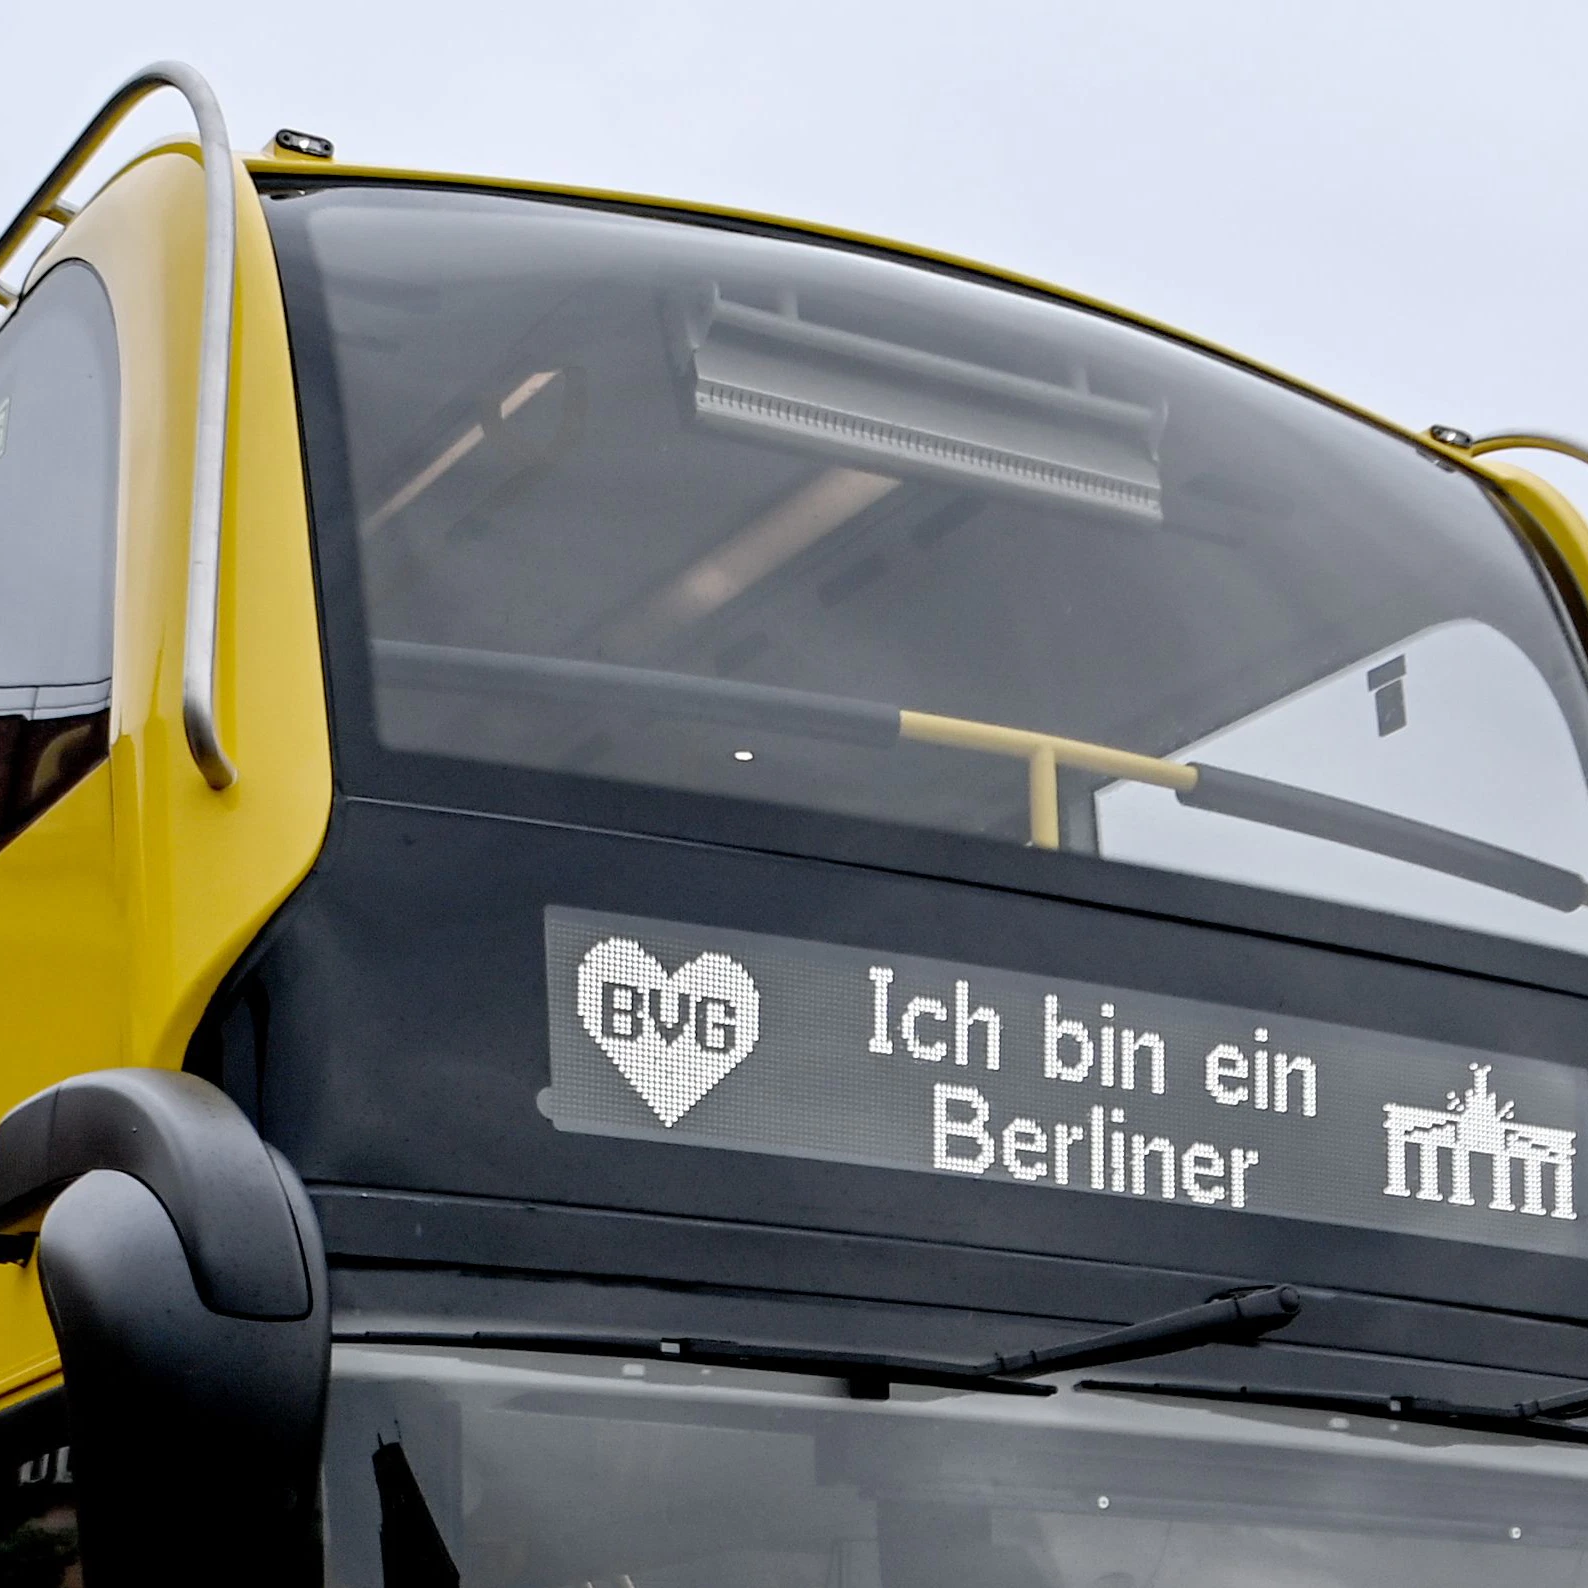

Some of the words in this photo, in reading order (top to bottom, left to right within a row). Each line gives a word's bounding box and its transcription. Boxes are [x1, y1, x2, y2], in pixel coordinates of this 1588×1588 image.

[602, 981, 738, 1054] BVG
[868, 965, 1001, 1070] Ich
[1043, 993, 1166, 1095] bin
[1204, 1027, 1317, 1118] ein
[932, 1083, 1259, 1209] Berliner
